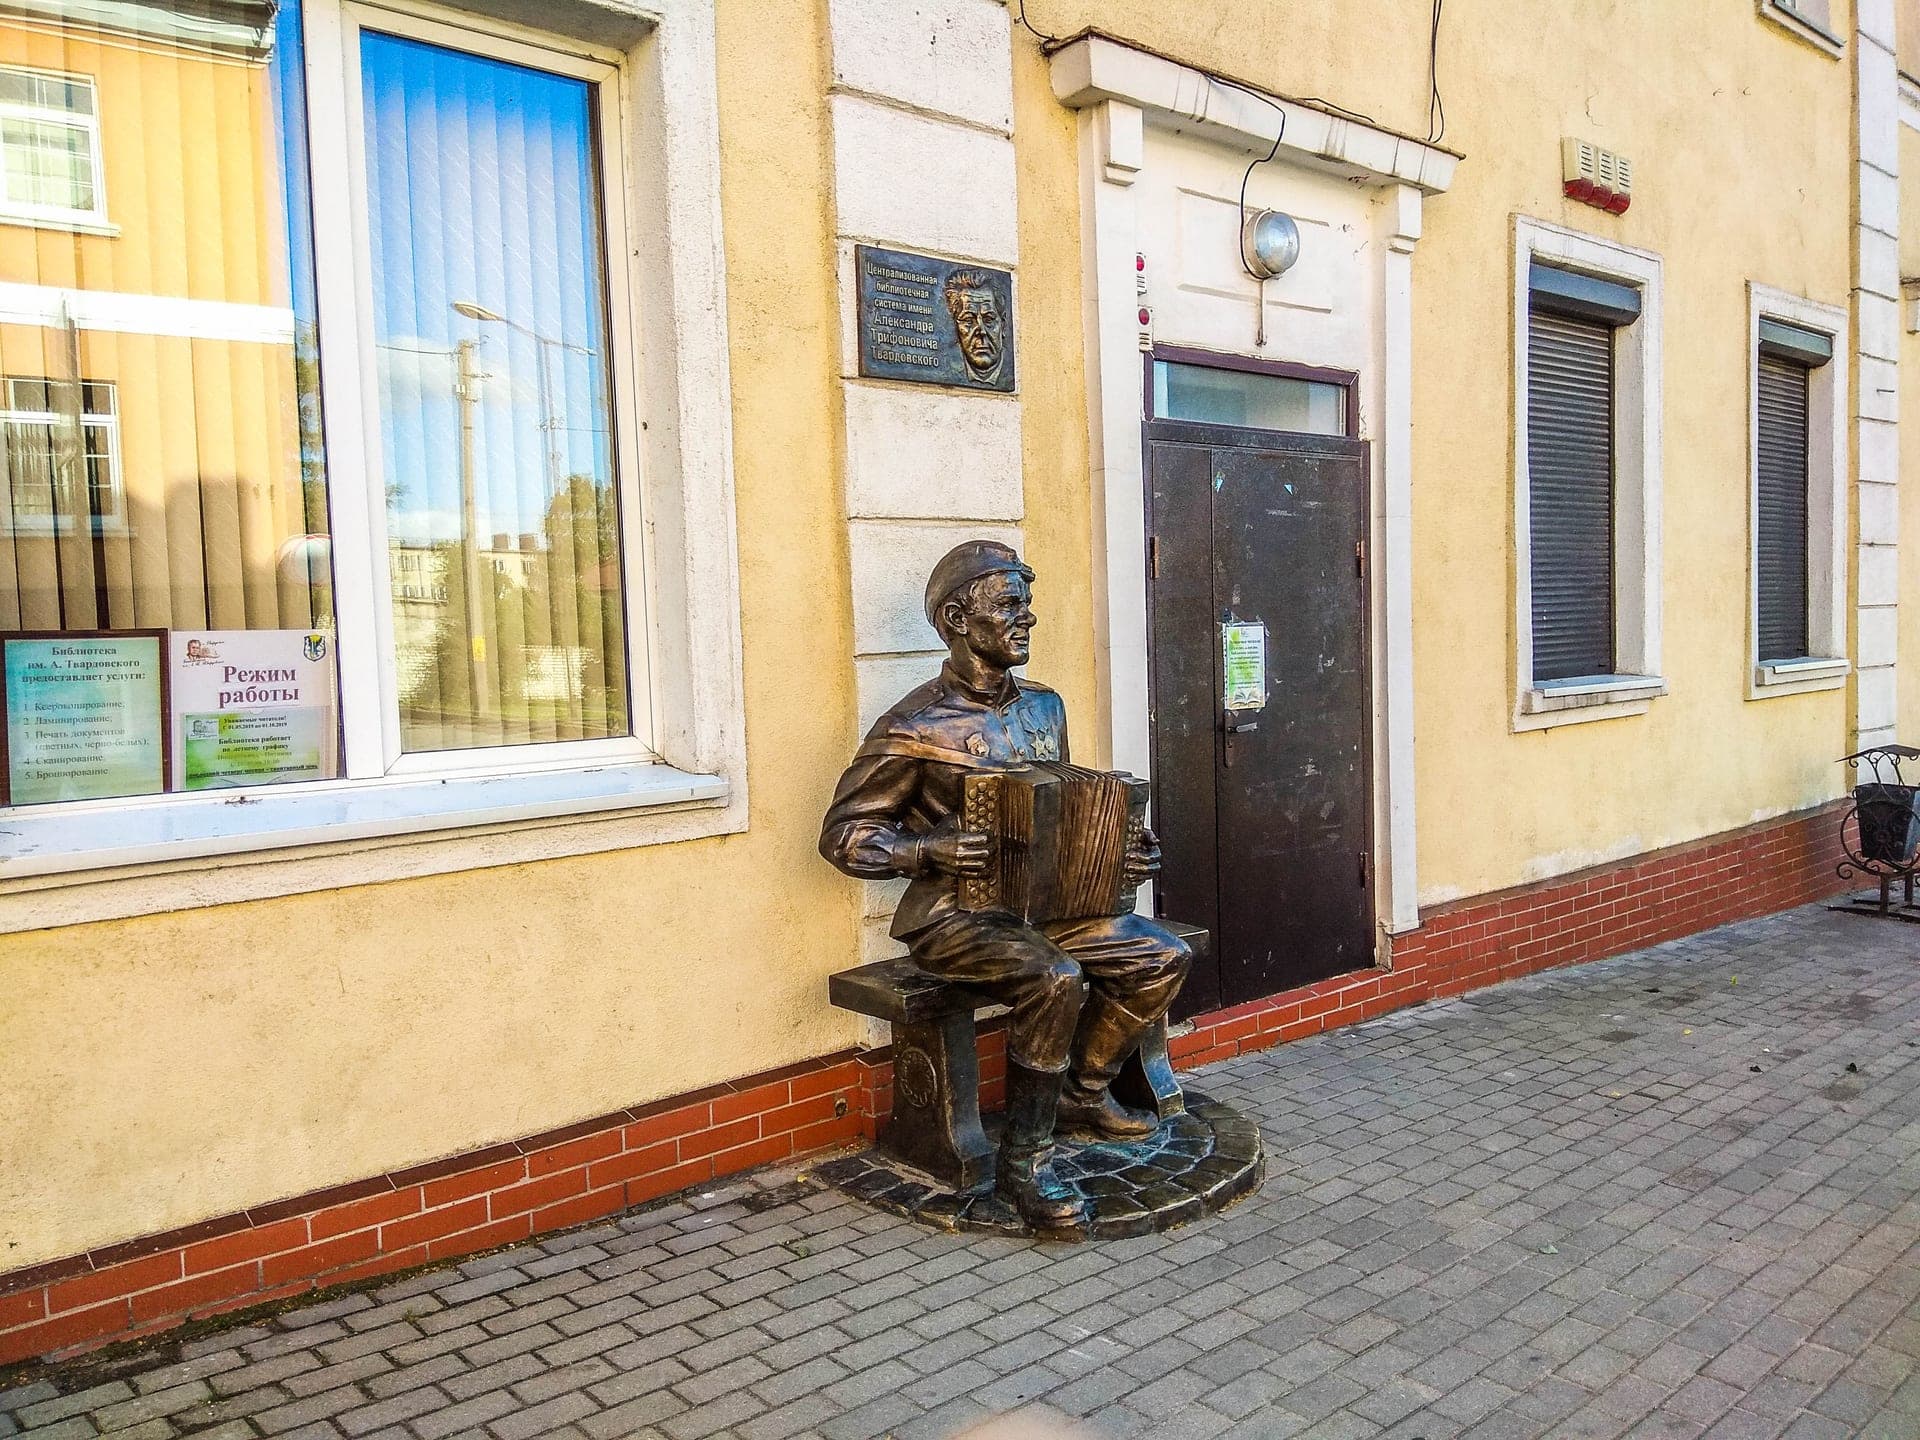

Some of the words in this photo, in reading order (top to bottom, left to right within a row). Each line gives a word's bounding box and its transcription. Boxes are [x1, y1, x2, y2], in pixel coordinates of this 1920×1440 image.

[867, 261, 938, 285] Централизованная
[876, 281, 929, 299] библиотечная
[874, 298, 907, 311] система
[908, 303, 933, 315] имени
[874, 311, 934, 333] Александра
[870, 327, 938, 350] Трифоновича
[871, 345, 939, 367] Твардовского
[52, 646, 117, 656] Библиотека
[27, 661, 47, 670] им.
[51, 660, 62, 669] А.
[65, 659, 140, 670] Твардовского
[22, 673, 103, 684] предоставляет
[106, 672, 146, 683] услуги:
[223, 665, 296, 683] Режим
[218, 685, 299, 709] работы
[35, 730, 69, 739] Печать
[218, 737, 260, 745] Библиотека
[261, 735, 291, 744] работает
